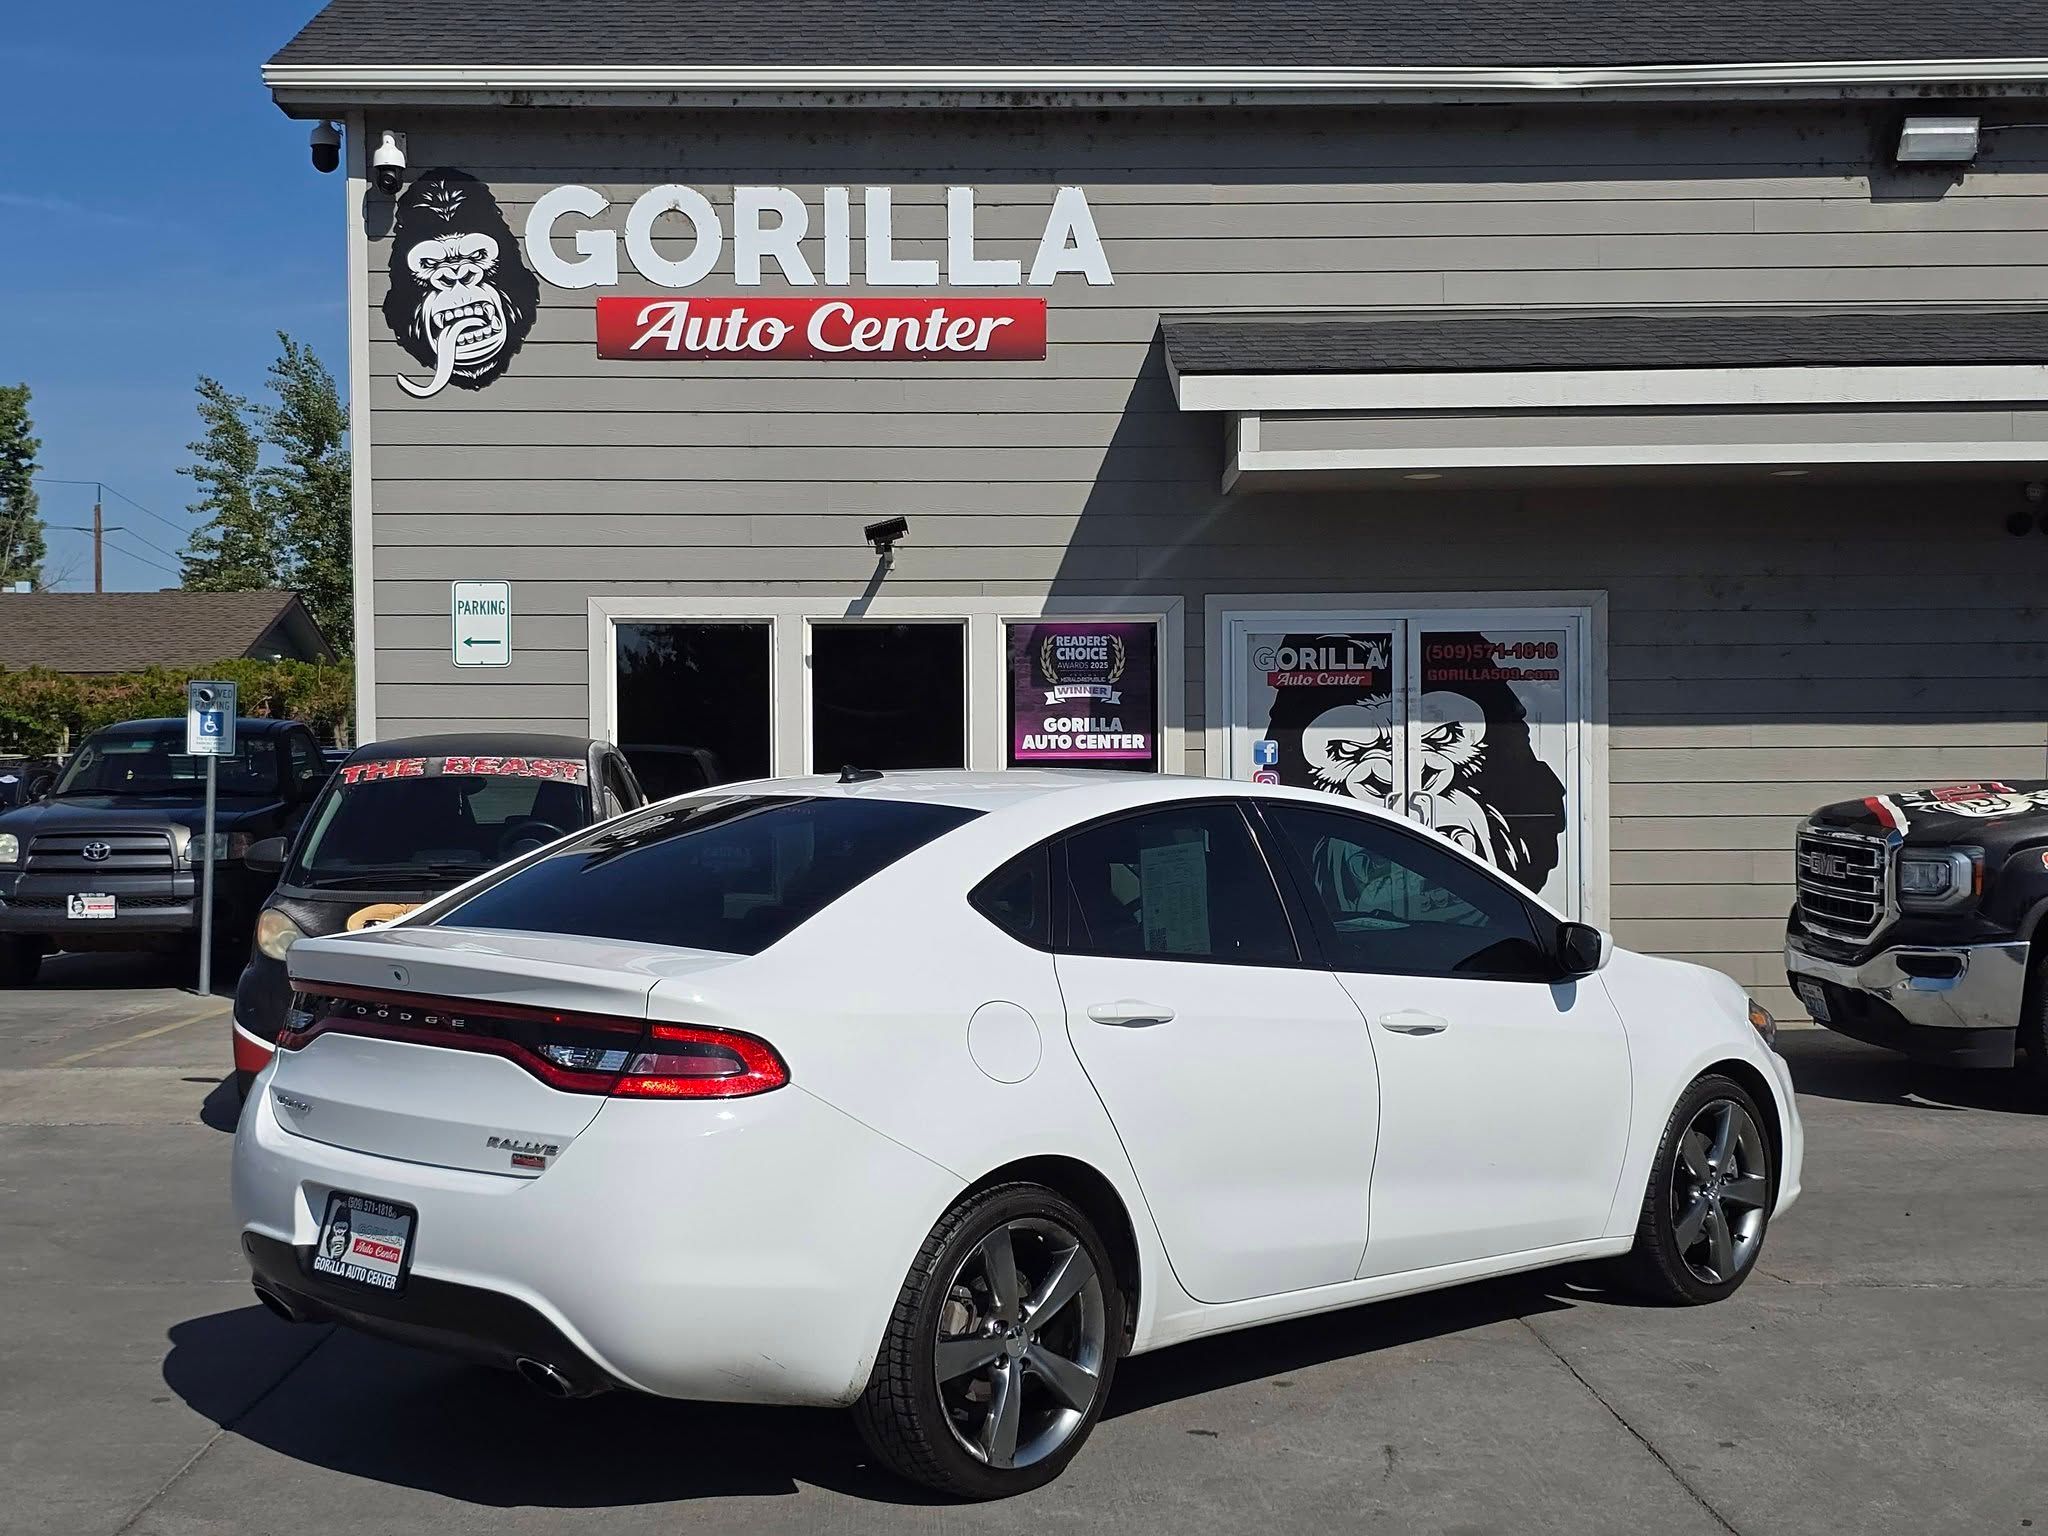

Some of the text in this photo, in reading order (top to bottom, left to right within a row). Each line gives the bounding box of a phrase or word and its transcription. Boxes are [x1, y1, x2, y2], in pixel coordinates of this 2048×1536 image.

[524, 184, 1115, 288] GORILLA
[629, 300, 1015, 353] Auto Center
[458, 600, 505, 615] PARKING
[1056, 647, 1108, 661] CHOICE
[1253, 646, 1386, 671] GORILLA
[1425, 641, 1559, 660] (509)571-1818
[1057, 661, 1109, 669] AWARDS 2025
[1276, 672, 1366, 686] Auto Center
[1427, 667, 1560, 681] GORILLA509.com
[192, 687, 233, 699] RVED
[1057, 685, 1108, 695] WINNER
[1043, 717, 1123, 732] GORILLA
[1022, 734, 1145, 750] AUTO CENTER
[340, 756, 586, 784] THE BEAST
[1810, 851, 1847, 879] GMC
[357, 1006, 465, 1028] DODGE
[486, 1136, 560, 1157] RALLYE
[314, 1257, 397, 1290] GORILLA AUTO CENTER
